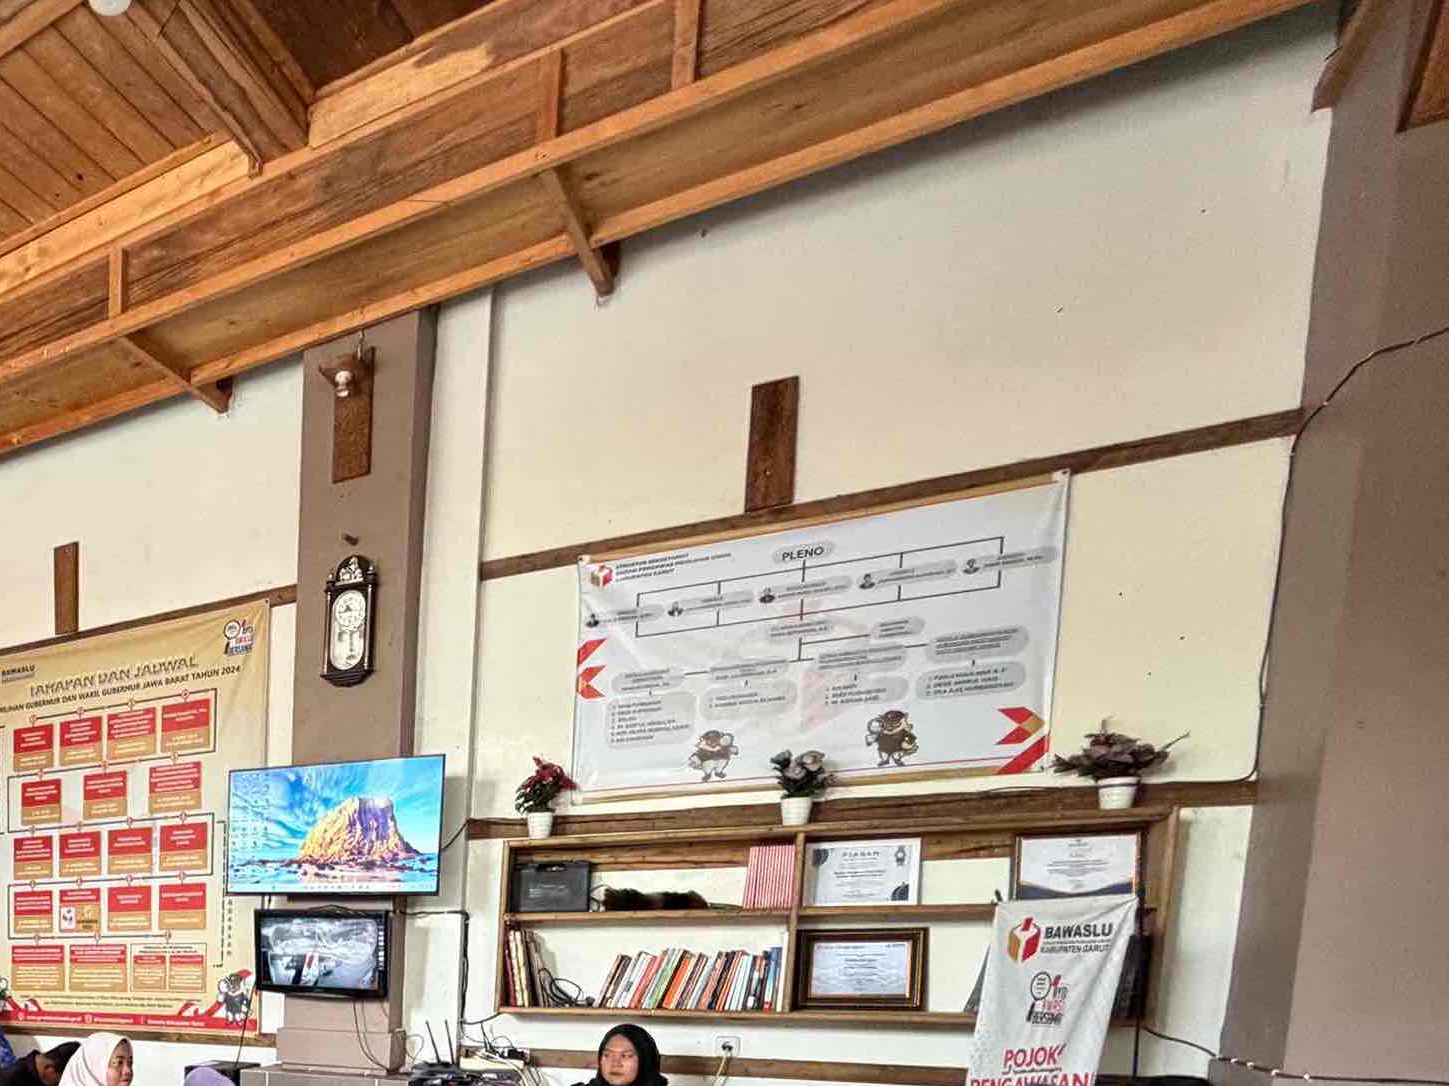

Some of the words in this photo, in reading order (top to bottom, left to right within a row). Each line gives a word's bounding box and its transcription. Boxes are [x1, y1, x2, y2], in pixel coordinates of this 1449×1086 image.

[781, 545, 825, 562] PLENO
[98, 667, 131, 687] DAN
[135, 655, 199, 679] JADWAL
[192, 668, 220, 681] TAHUN
[1045, 923, 1114, 939] BAWASLU
[1003, 1046, 1060, 1069] POJOK
